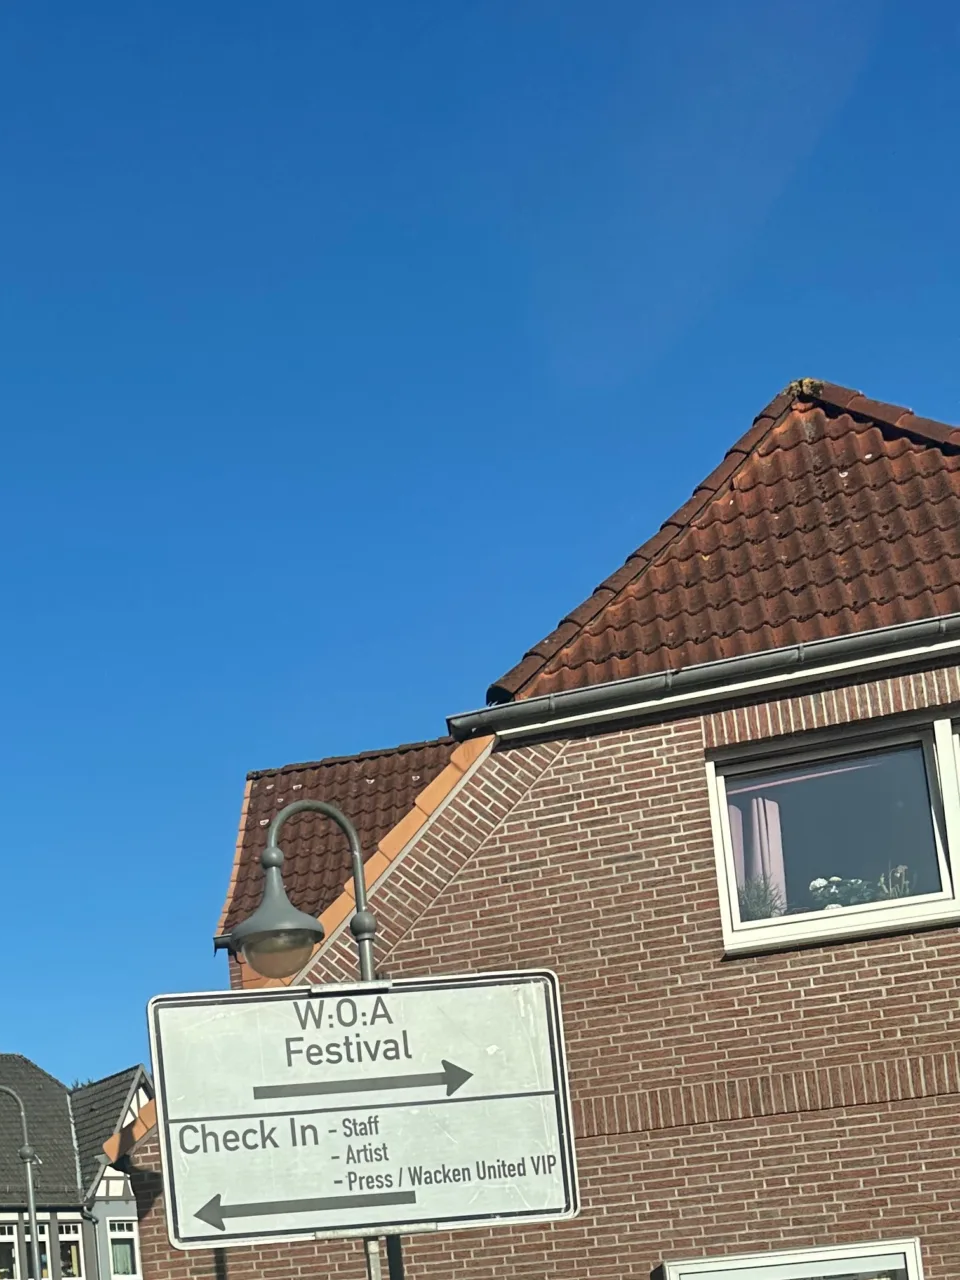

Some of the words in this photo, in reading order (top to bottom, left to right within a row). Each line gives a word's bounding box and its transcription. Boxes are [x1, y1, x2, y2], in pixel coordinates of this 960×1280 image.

[284, 1029, 413, 1068] Festival
[178, 1121, 279, 1155] Check
[289, 1117, 320, 1147] In
[342, 1115, 380, 1138] Staff
[345, 1142, 390, 1166] Artist
[348, 1169, 393, 1192] Press
[409, 1163, 472, 1188] Wacken
[476, 1157, 527, 1181] United
[529, 1153, 557, 1177] VIP
